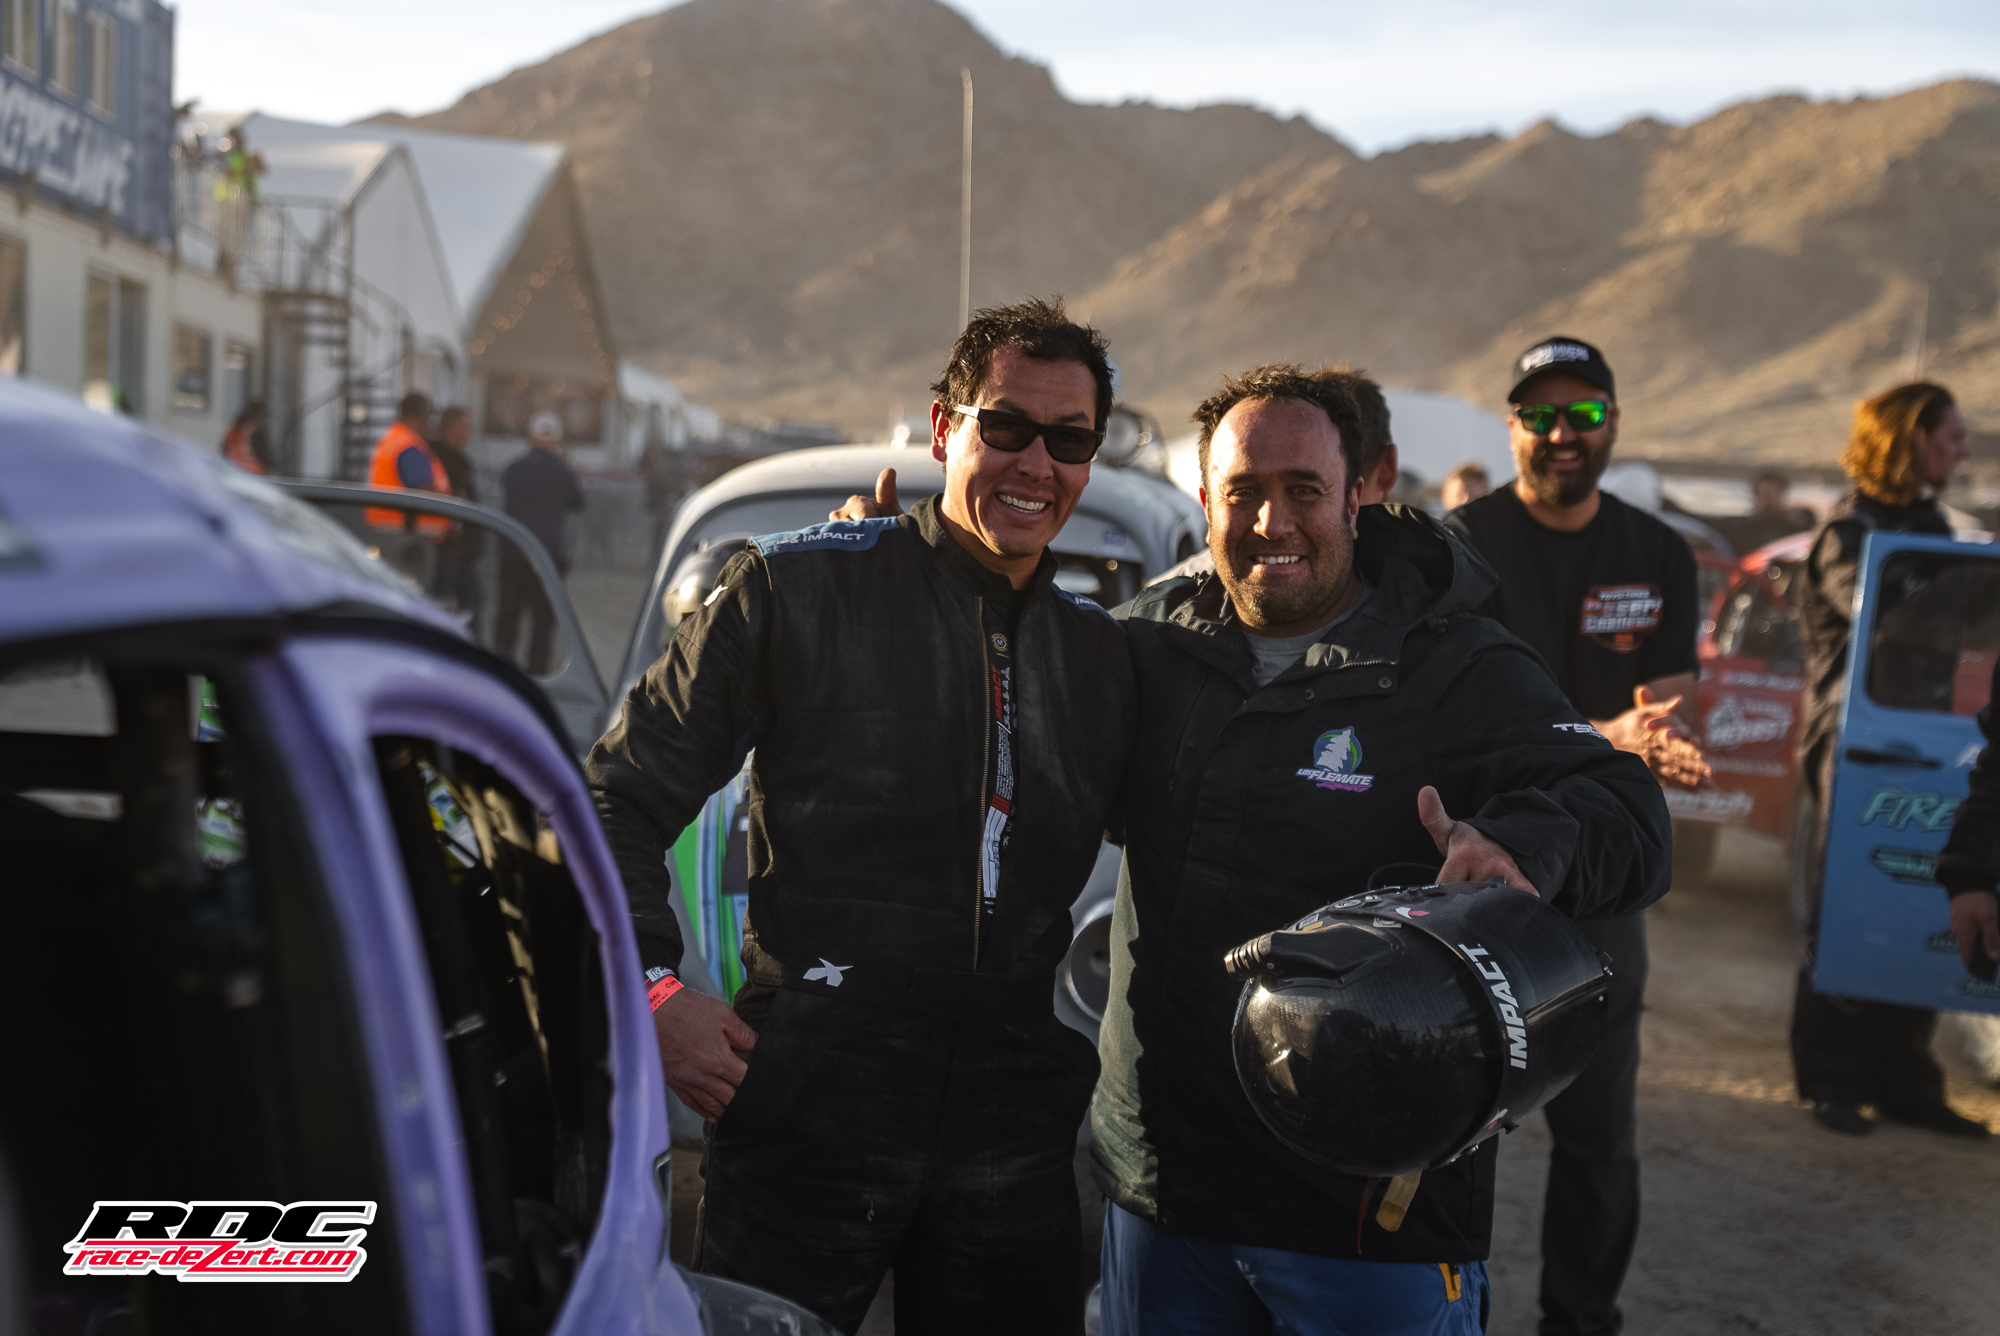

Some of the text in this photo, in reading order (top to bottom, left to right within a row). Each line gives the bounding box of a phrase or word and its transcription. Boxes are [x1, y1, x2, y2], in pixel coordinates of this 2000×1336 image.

[802, 532, 865, 542] IMPACT
[992, 664, 1004, 723] IMPACT
[1458, 942, 1528, 1070] IMPACT
